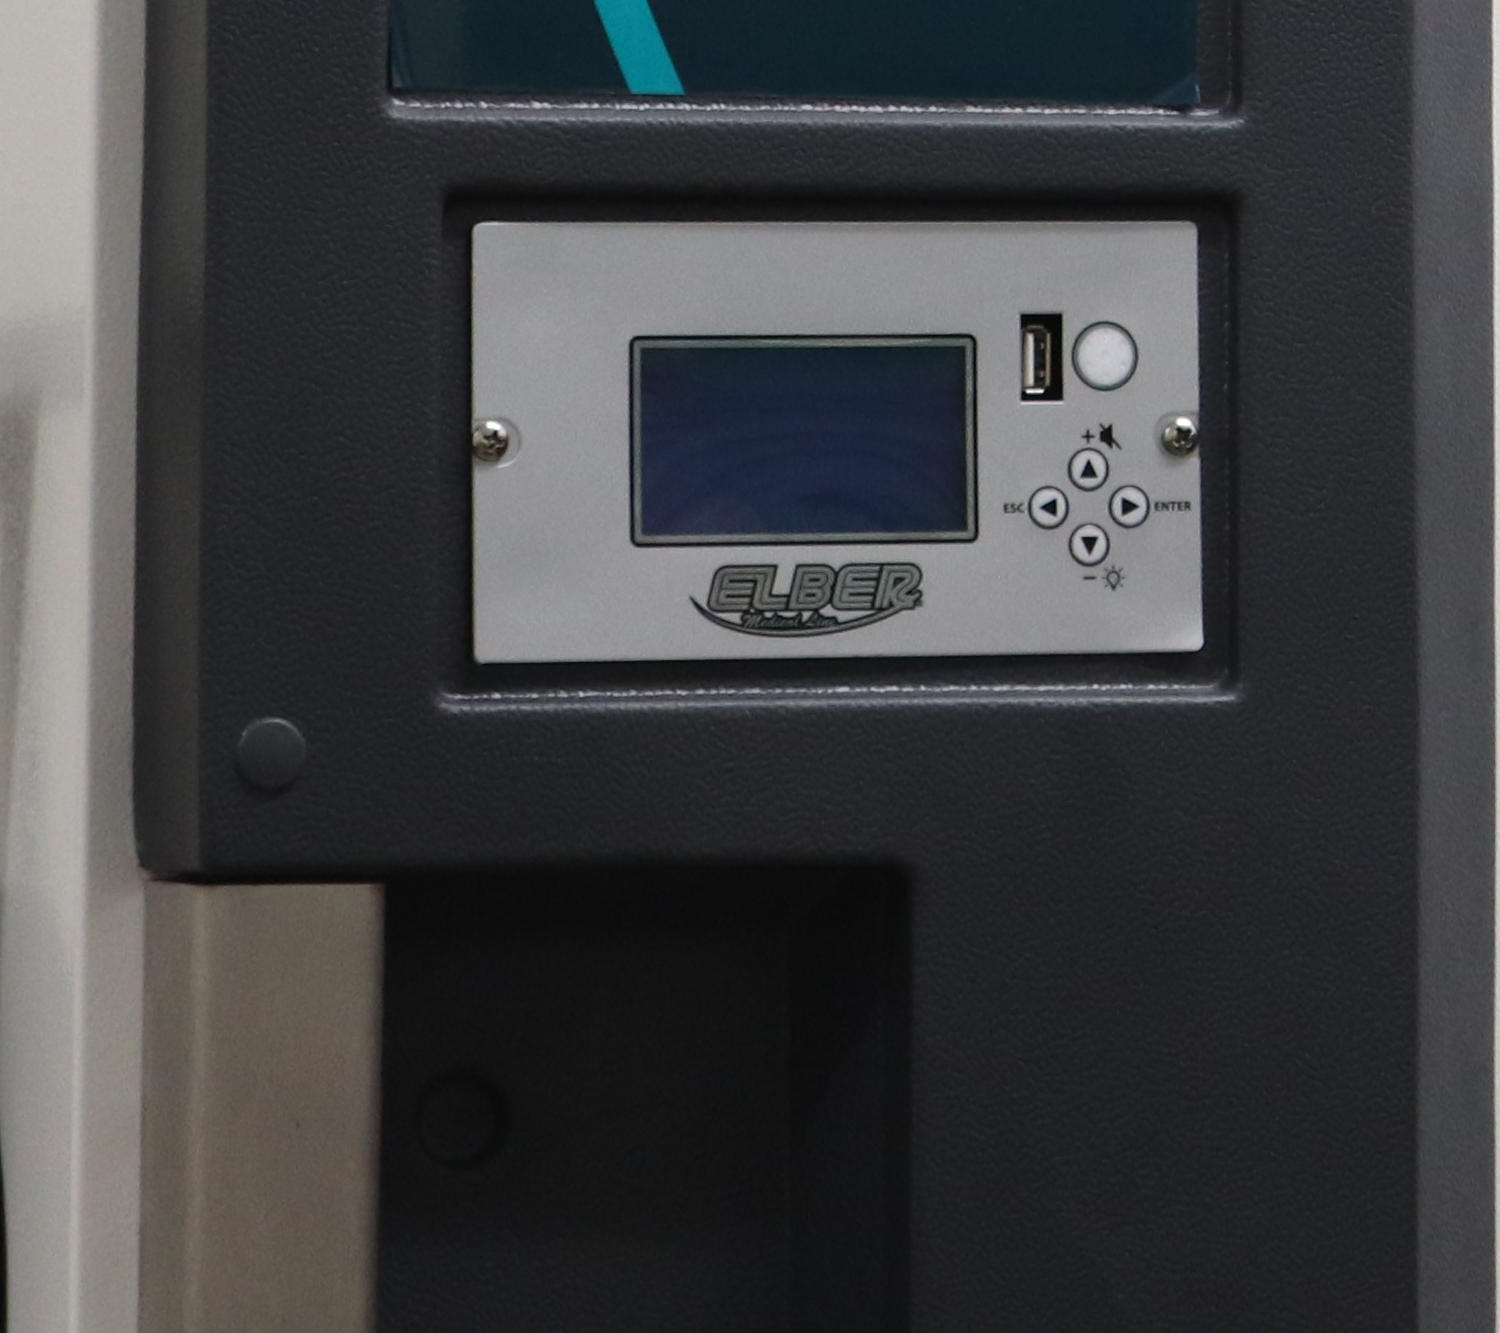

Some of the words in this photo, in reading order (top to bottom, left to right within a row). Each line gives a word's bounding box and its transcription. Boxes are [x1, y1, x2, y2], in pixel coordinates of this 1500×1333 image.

[1003, 504, 1024, 513] ESC
[1154, 502, 1191, 511] ENTER
[708, 563, 923, 612] ELBER
